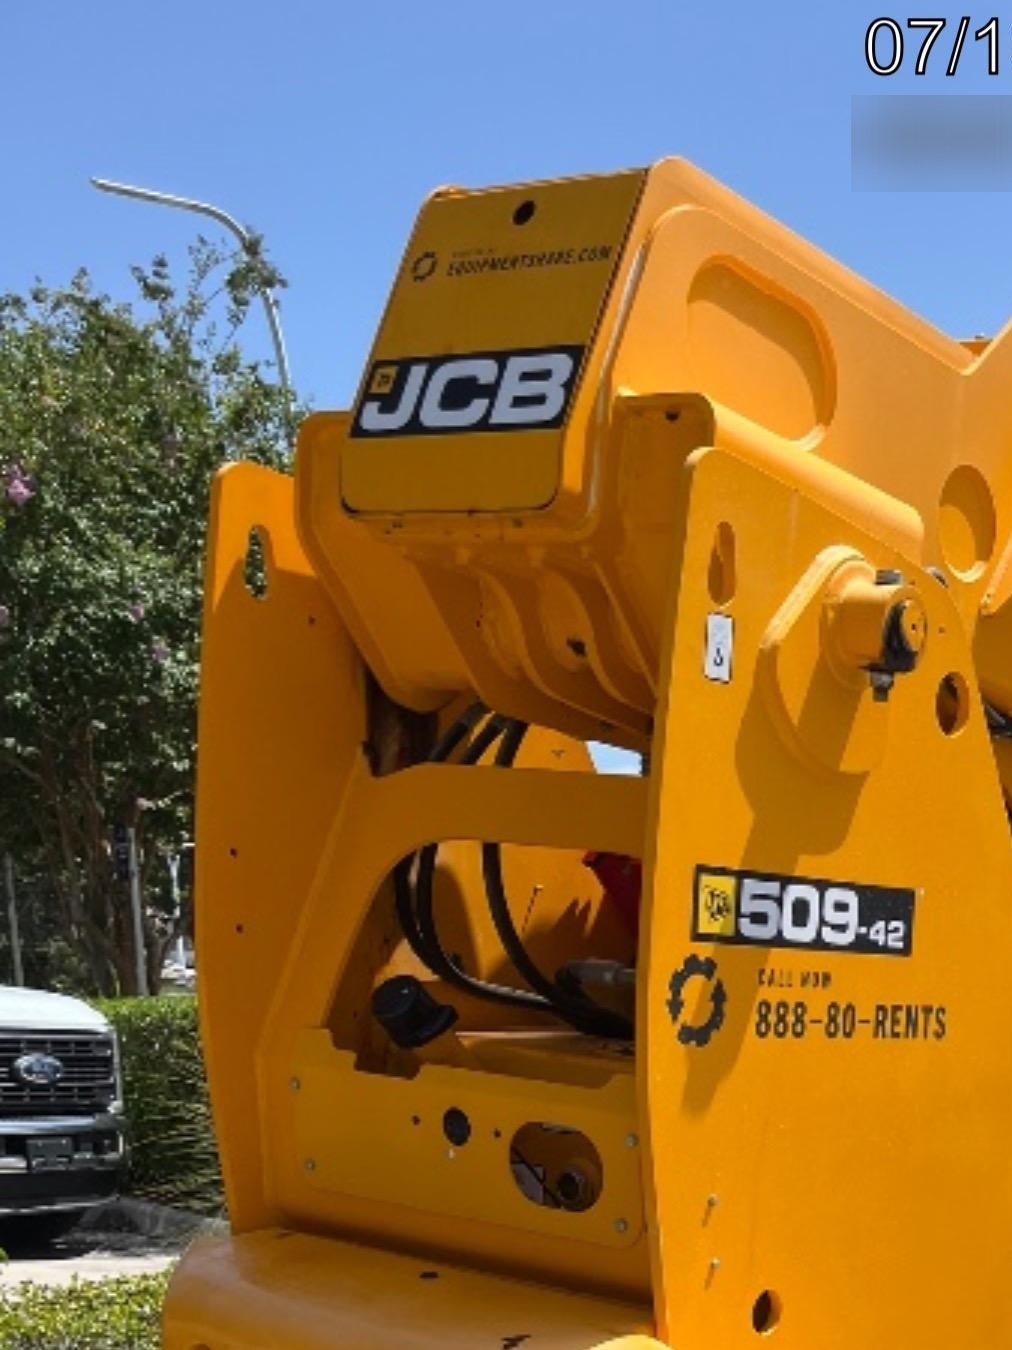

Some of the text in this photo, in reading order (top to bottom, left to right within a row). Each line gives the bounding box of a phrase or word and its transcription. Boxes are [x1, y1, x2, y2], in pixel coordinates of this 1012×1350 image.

[360, 353, 574, 431] JCB
[737, 878, 905, 950] 509-42
[756, 999, 947, 1041] 888-80-RENTS
